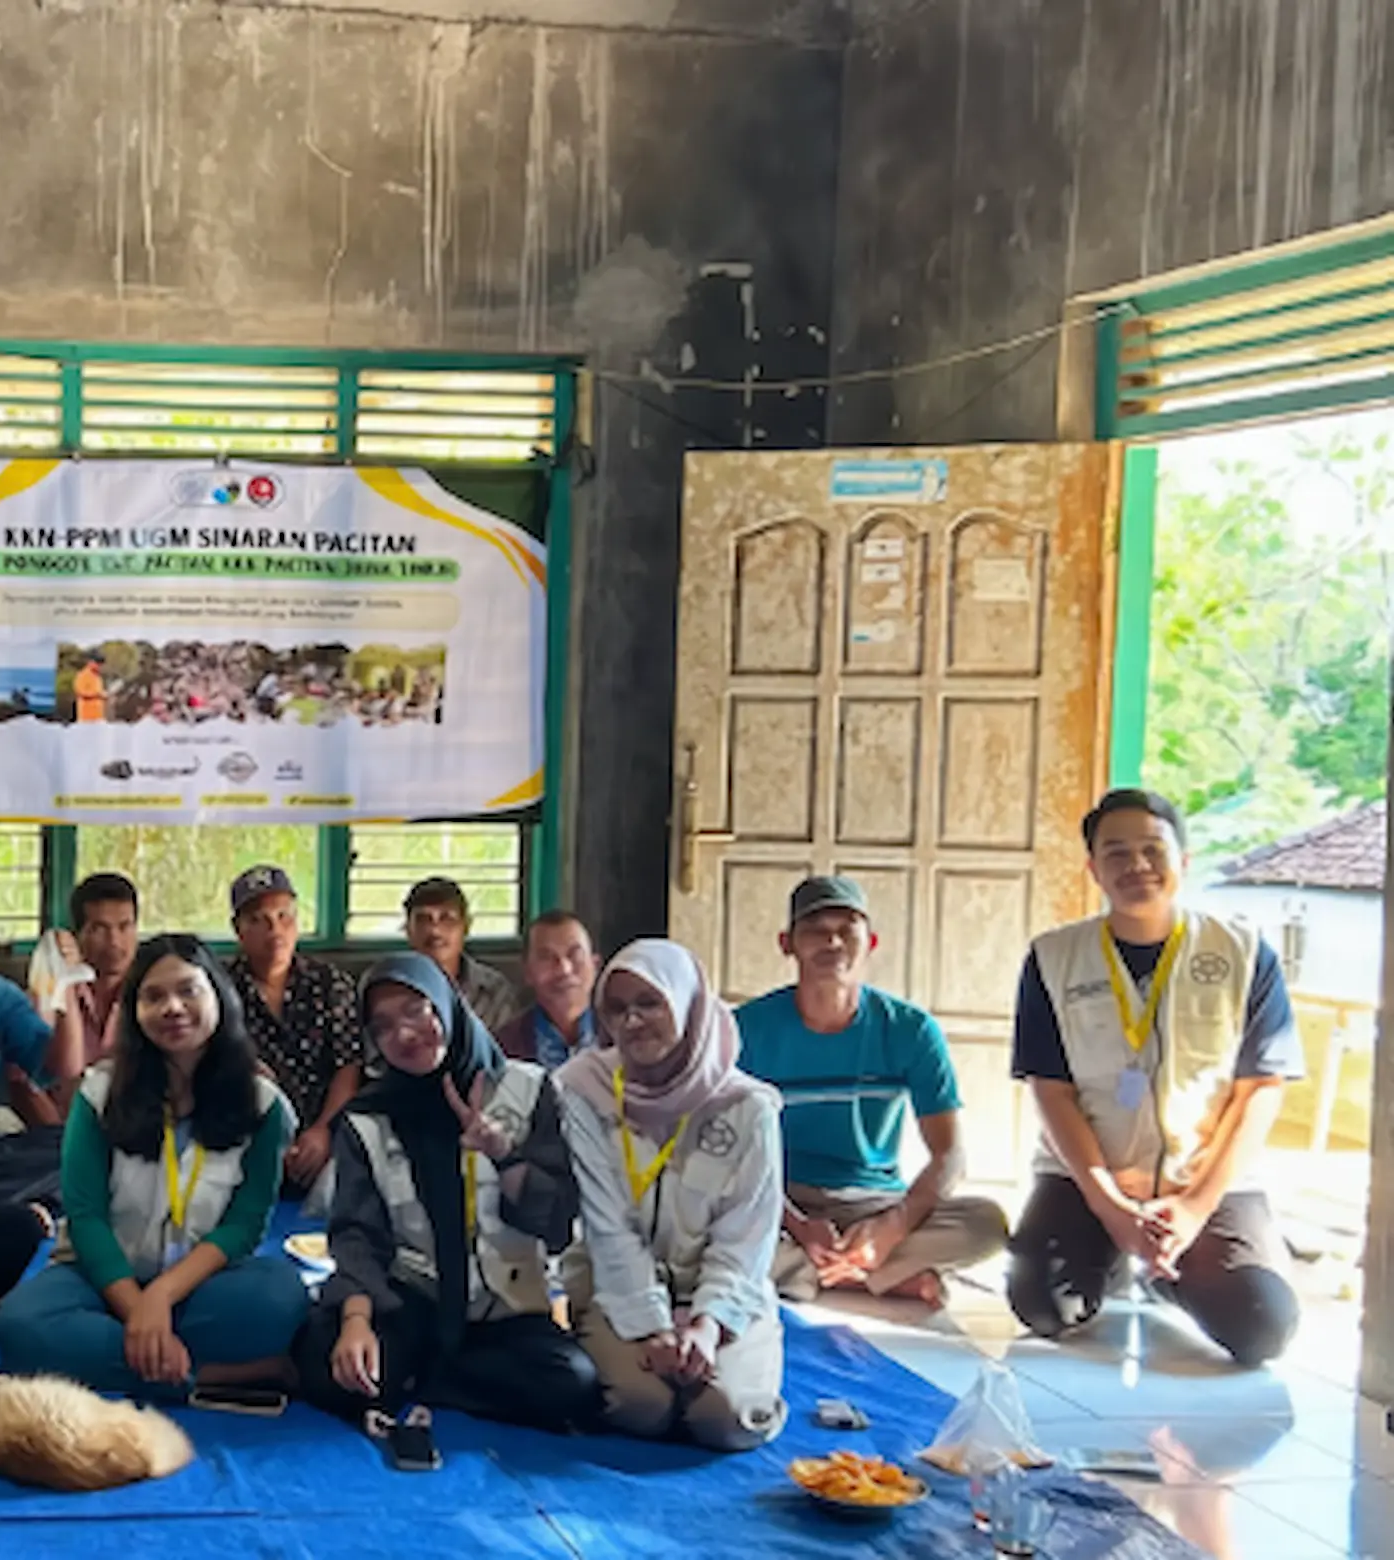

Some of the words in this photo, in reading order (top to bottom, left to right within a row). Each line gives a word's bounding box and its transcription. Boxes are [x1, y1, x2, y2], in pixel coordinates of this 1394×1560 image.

[4, 526, 123, 548] KKN-PPM
[129, 527, 190, 549] UGM
[197, 527, 306, 550] SINARAN
[313, 532, 417, 554] PACITAN
